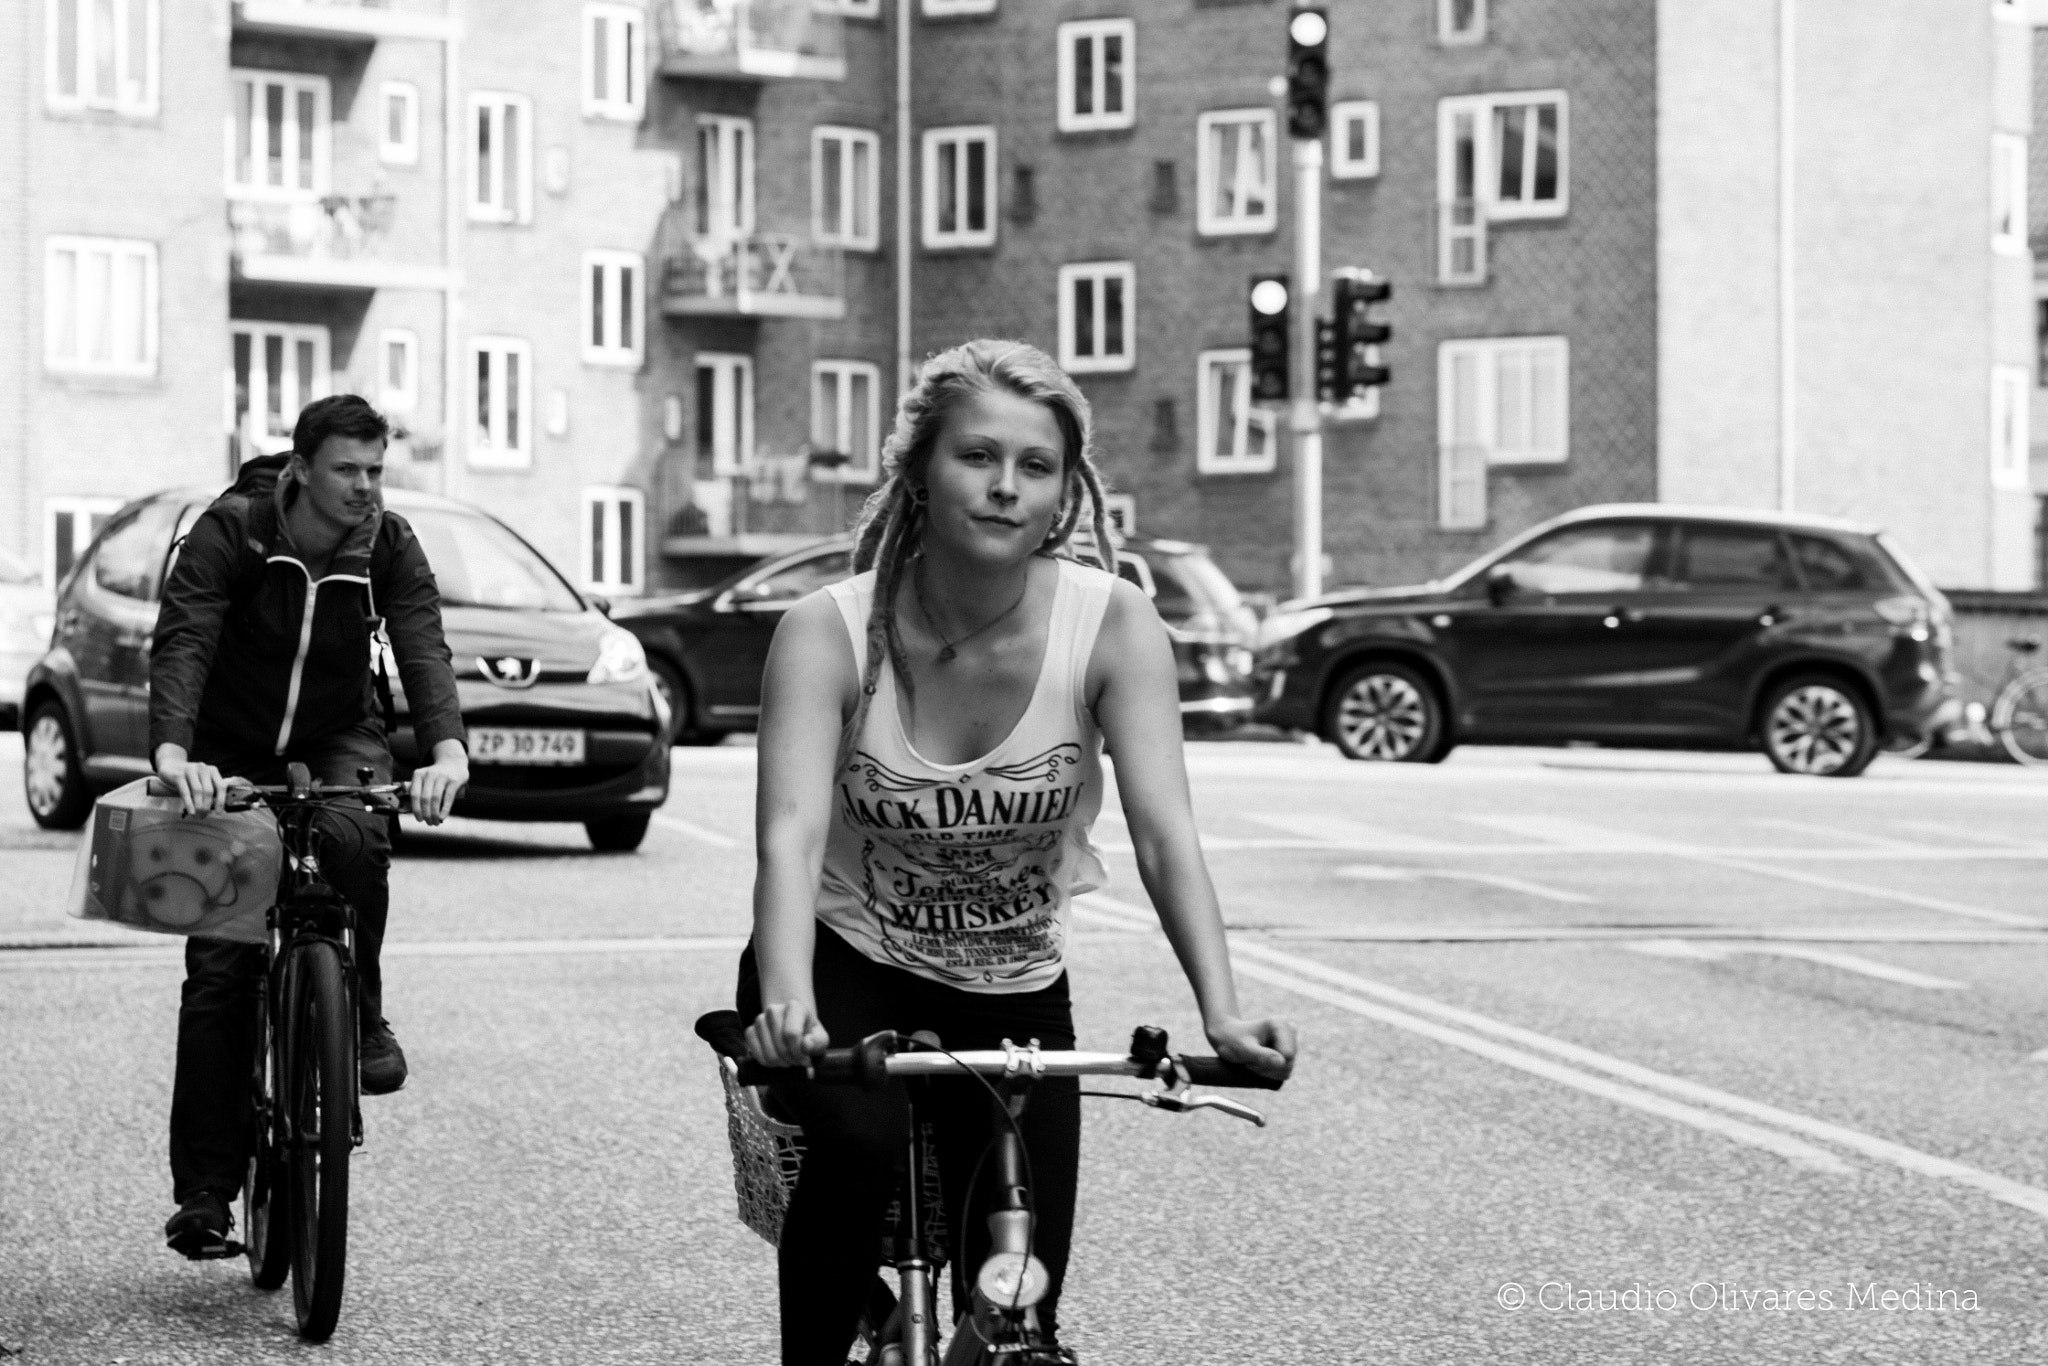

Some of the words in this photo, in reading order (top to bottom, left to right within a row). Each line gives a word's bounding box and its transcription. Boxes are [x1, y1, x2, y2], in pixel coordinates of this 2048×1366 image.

[478, 733, 504, 754] ZP
[541, 734, 576, 754] 749
[841, 783, 931, 830] JACK
[961, 828, 1018, 841] TIME
[889, 883, 1052, 931] WHISKEY
